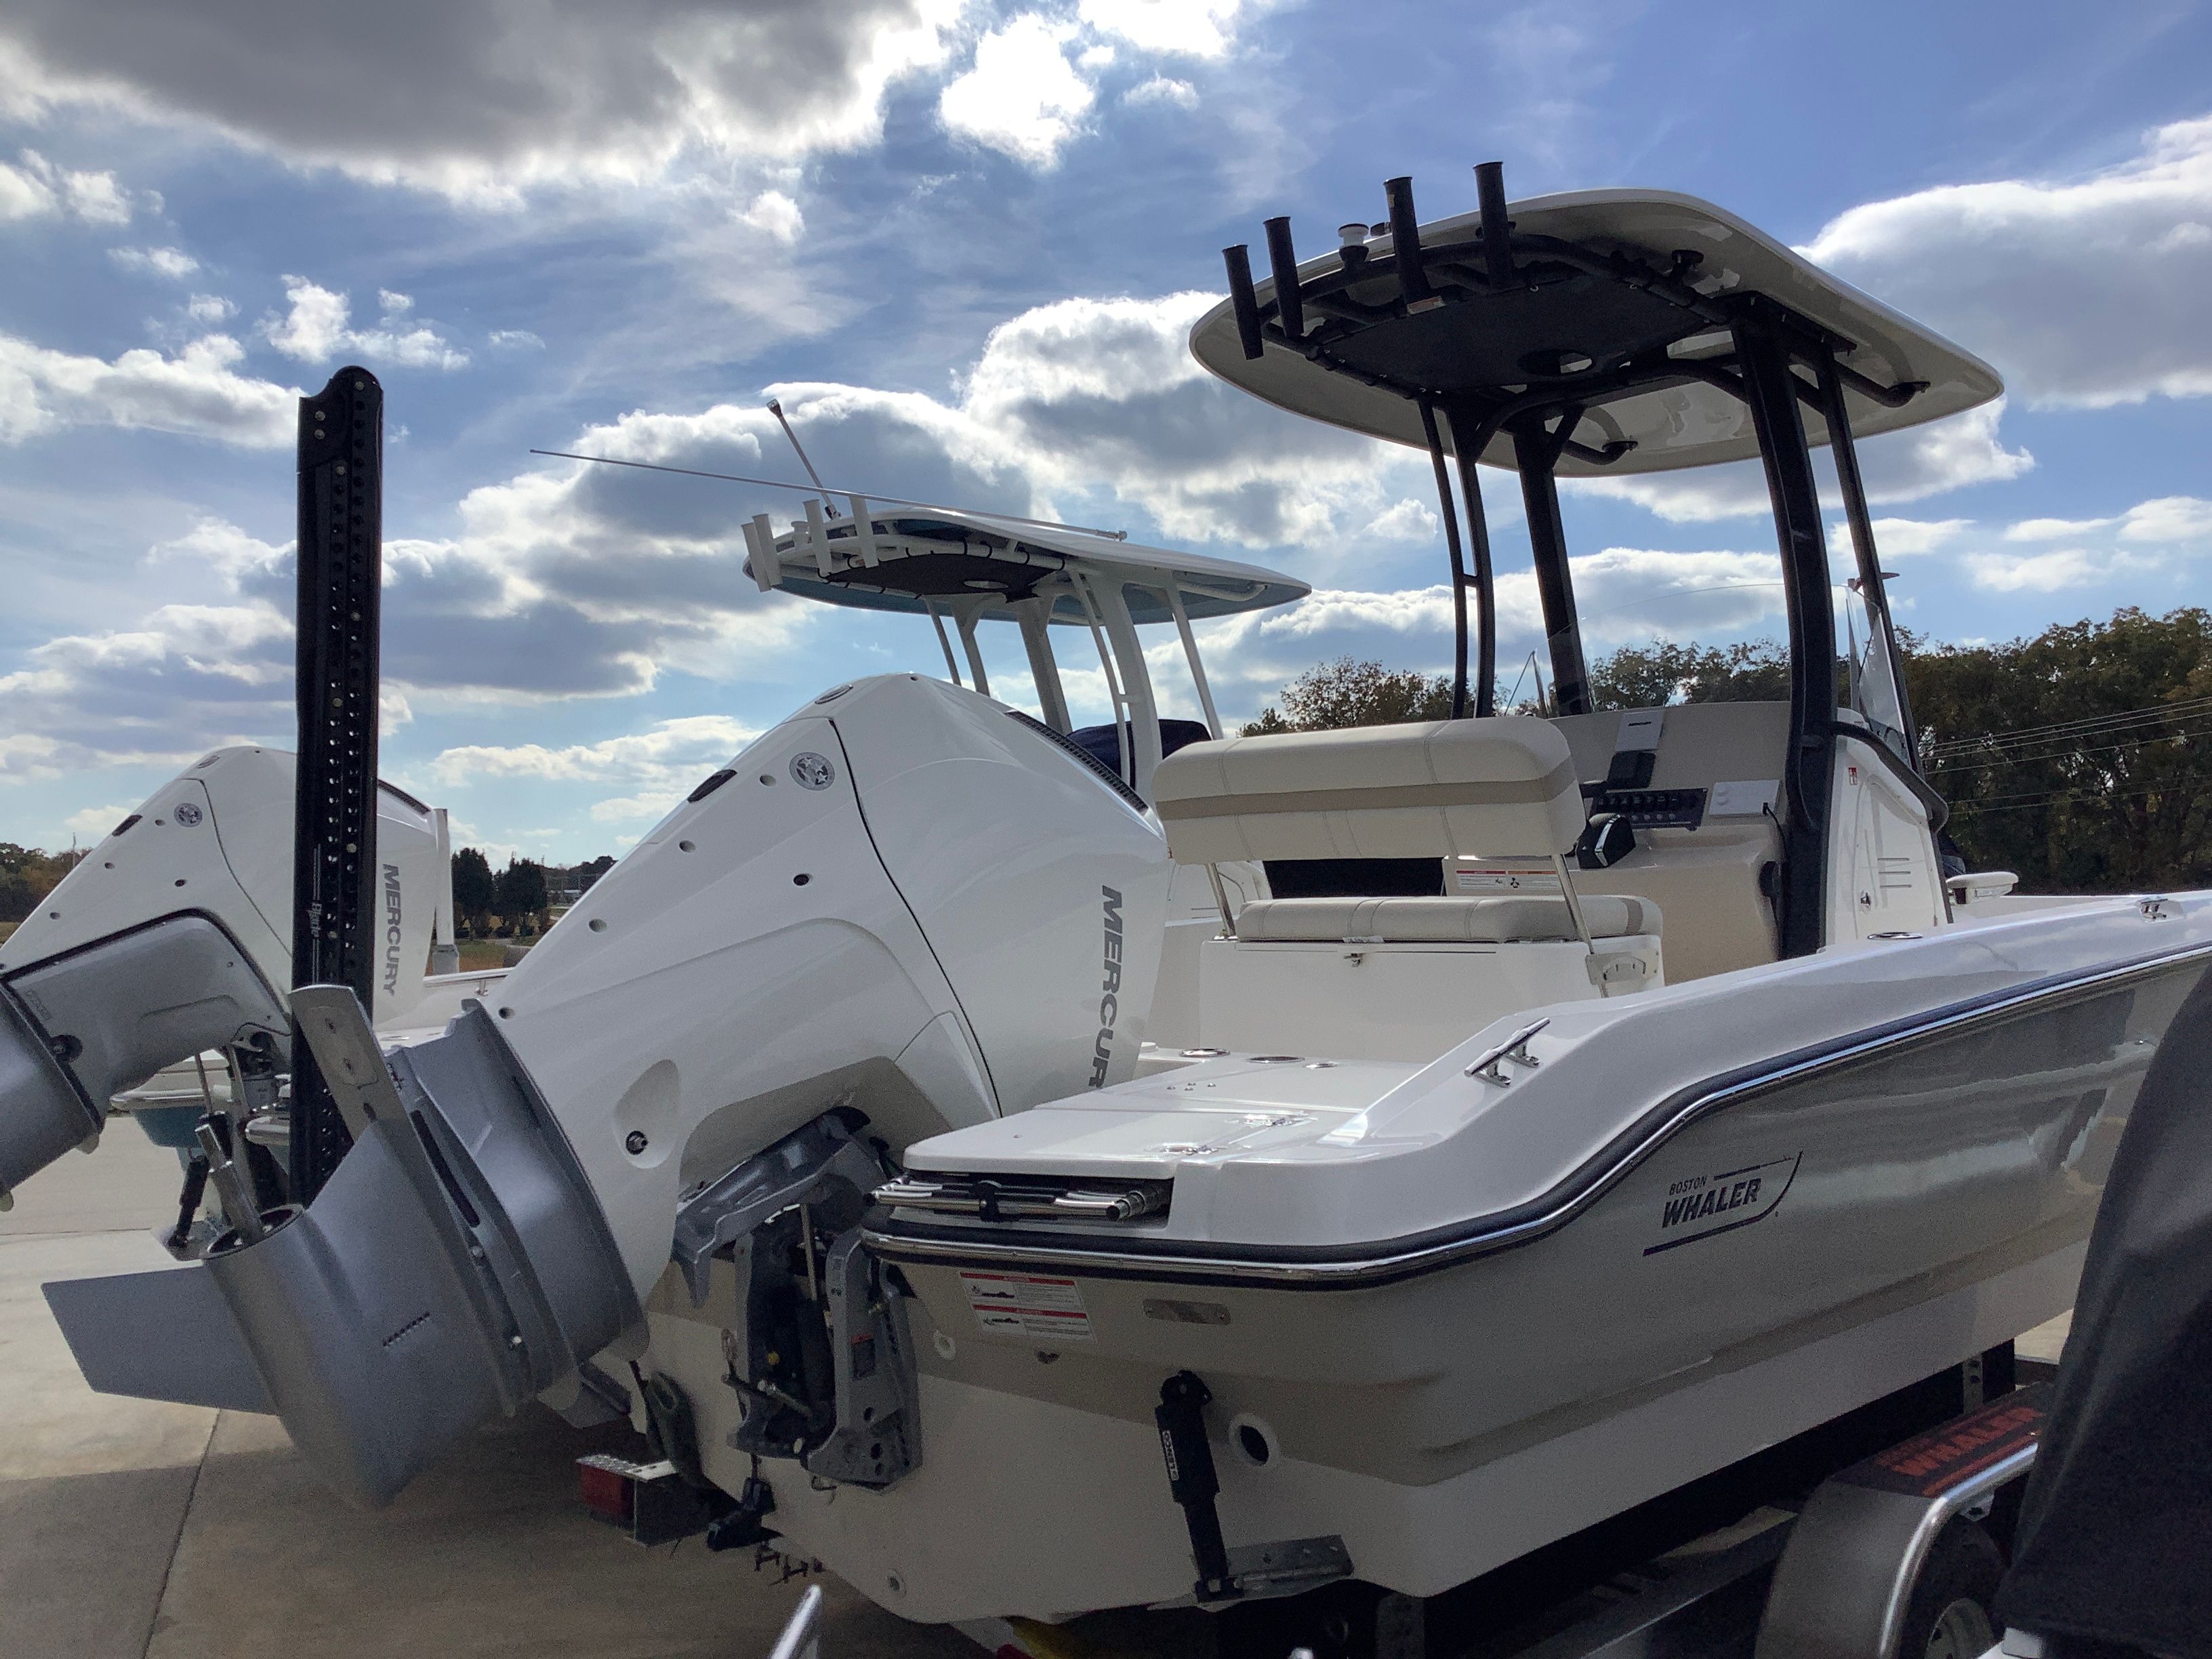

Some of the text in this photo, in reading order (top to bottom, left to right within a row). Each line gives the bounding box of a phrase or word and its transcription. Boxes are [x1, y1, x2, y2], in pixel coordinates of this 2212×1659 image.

[382, 863, 402, 996] MERCURY
[1088, 884, 1123, 1088] MERCUR
[1662, 1178, 1762, 1228] WHALER
[1669, 1175, 1708, 1195] BOSTON
